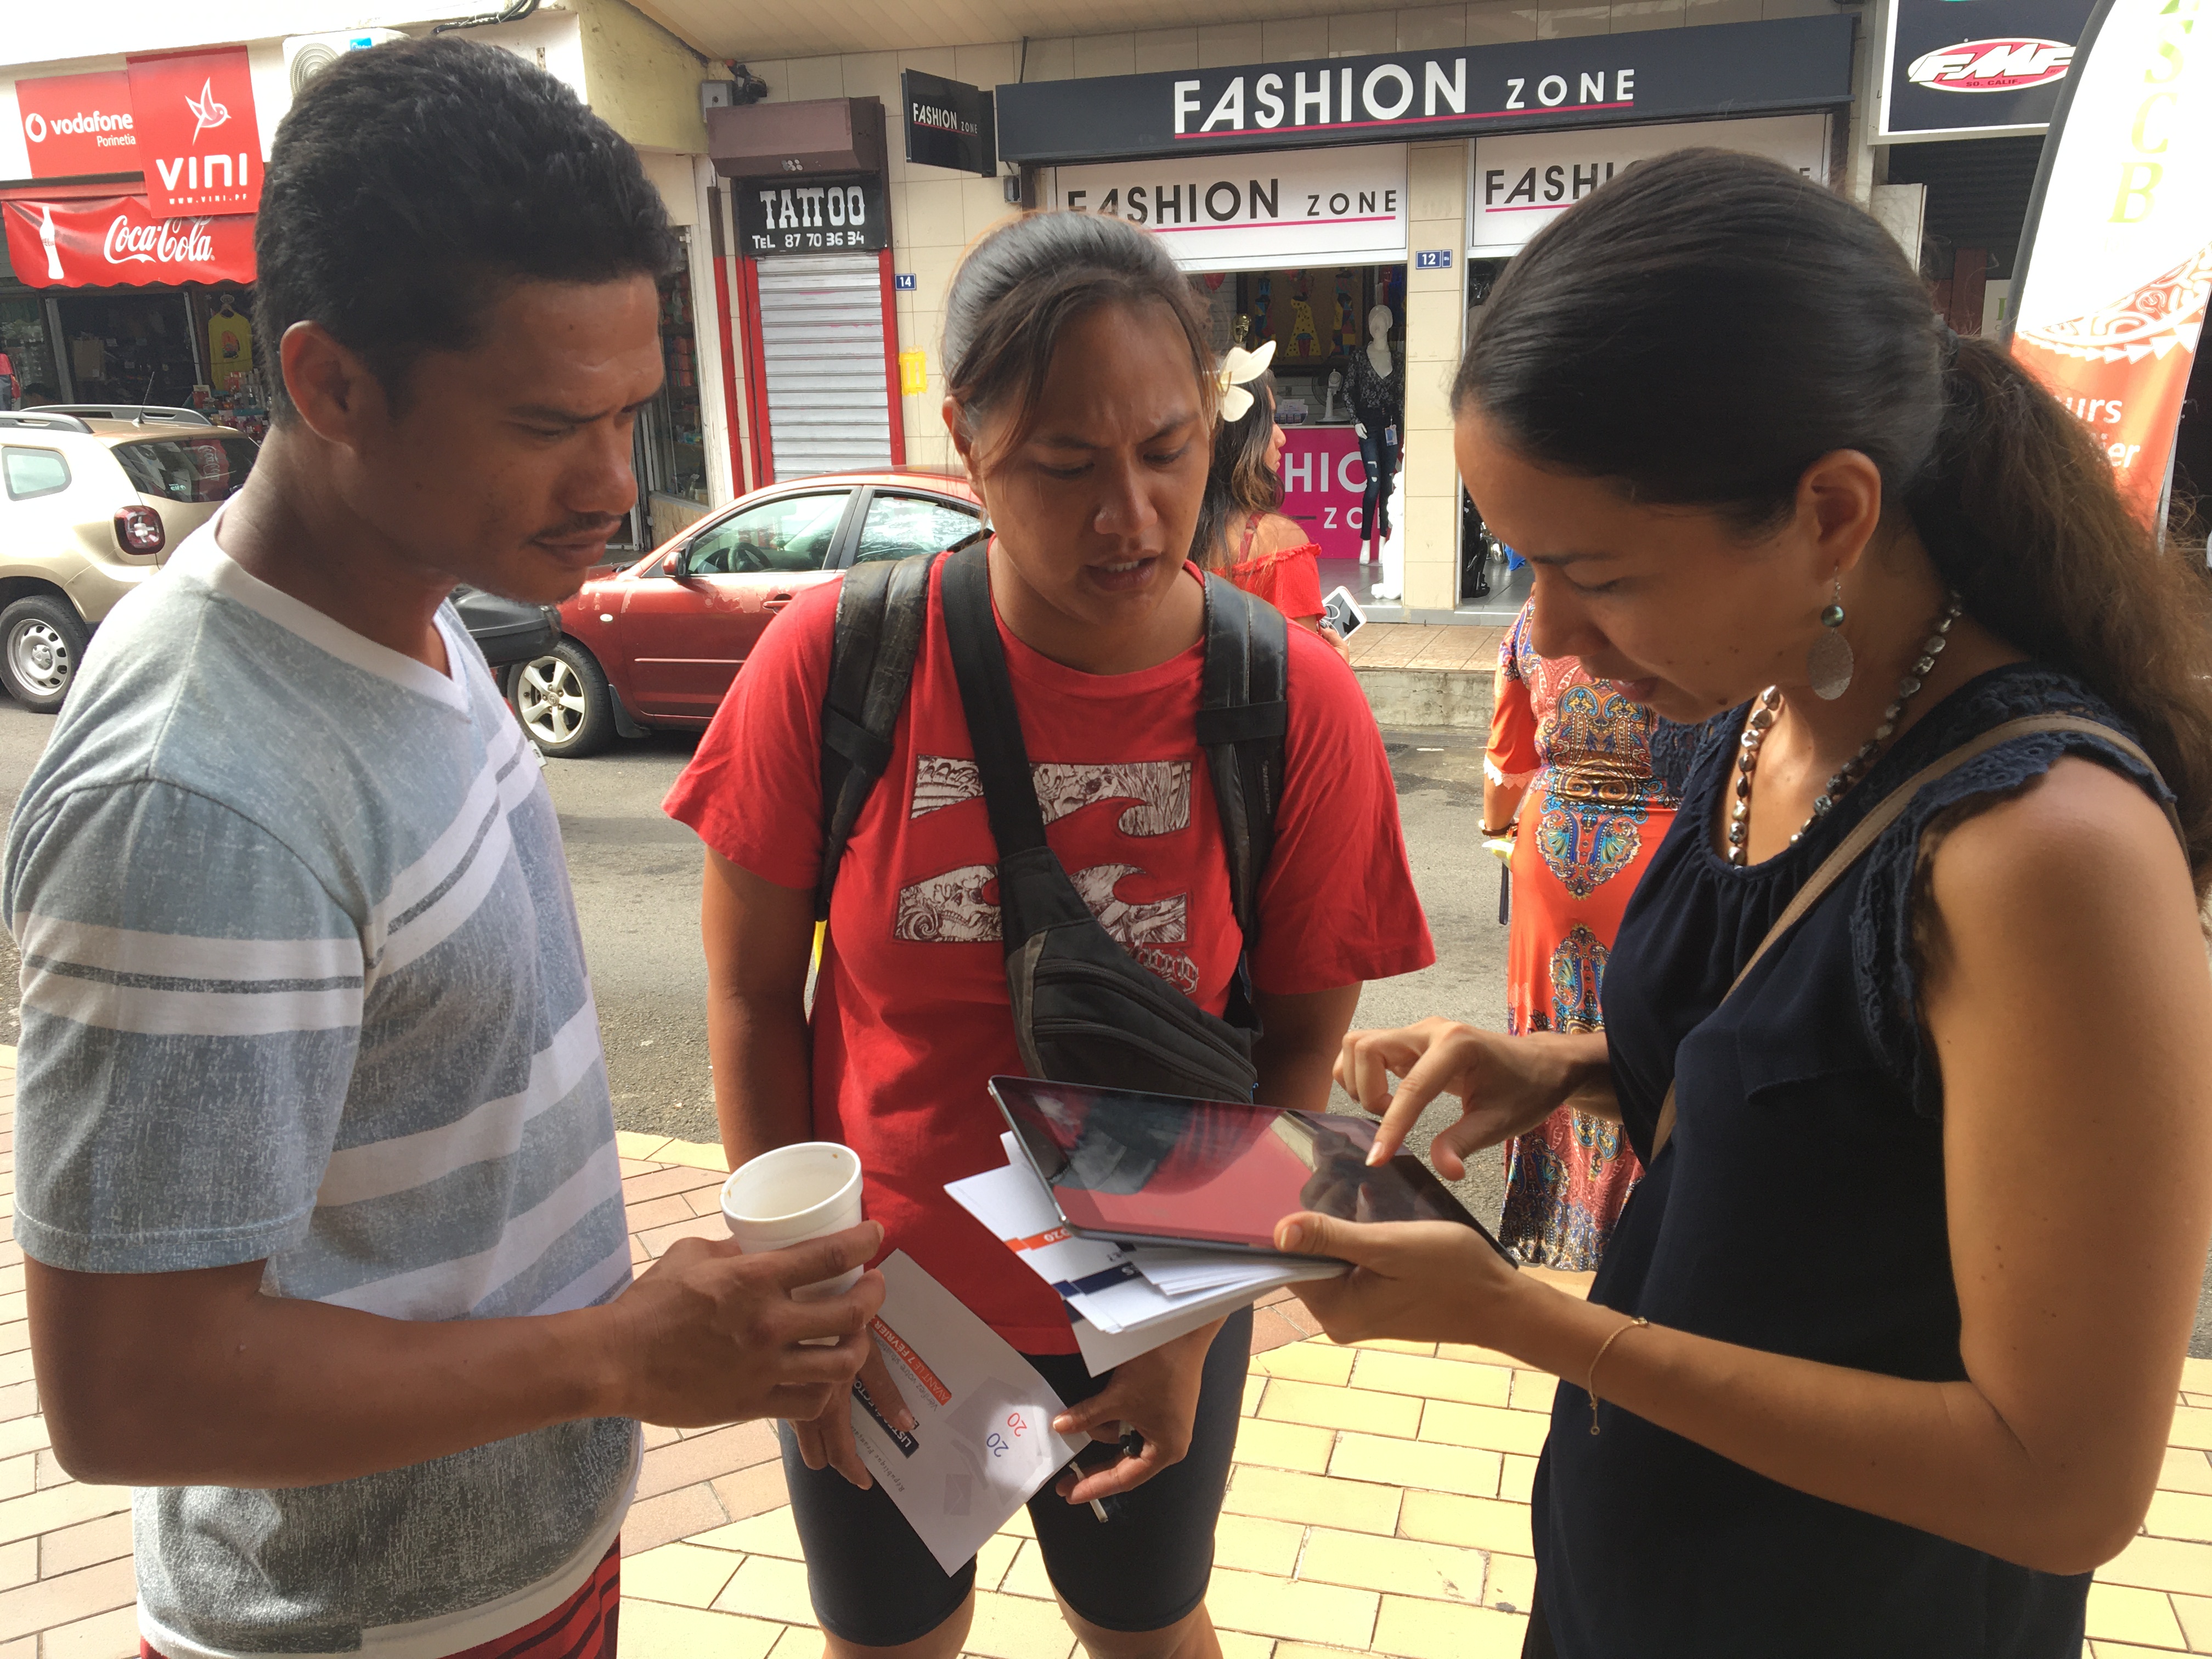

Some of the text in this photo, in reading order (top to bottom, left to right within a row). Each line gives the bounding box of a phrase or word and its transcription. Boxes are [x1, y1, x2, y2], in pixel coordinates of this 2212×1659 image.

[1909, 43, 2076, 82] FMF
[1175, 58, 1635, 133] FASHION ZONE
[50, 110, 133, 135] vodafone
[913, 103, 978, 134] FASHION ZONE
[2107, 0, 2197, 223] SCB
[97, 133, 136, 147] Porinetia
[1486, 160, 1646, 205] FASHI
[759, 185, 866, 229] TATTOO
[1068, 179, 1397, 225] FASHION ZONE
[103, 214, 213, 264] Coca-Cola
[785, 233, 801, 248] 87
[806, 233, 822, 247] 70
[826, 232, 843, 246] 36
[847, 230, 865, 245] 34
[1422, 253, 1436, 265] 12
[899, 276, 911, 287] 14
[2055, 396, 2123, 424] urs
[1285, 451, 1402, 493] HIO
[1323, 507, 1381, 529] ZO
[873, 1320, 950, 1401] AVANT LE 7 FÉVRIER
[899, 1363, 917, 1384] votre
[915, 1382, 938, 1412] Vérifiez
[1007, 1412, 1027, 1436] 20
[986, 1432, 1009, 1457] 20
